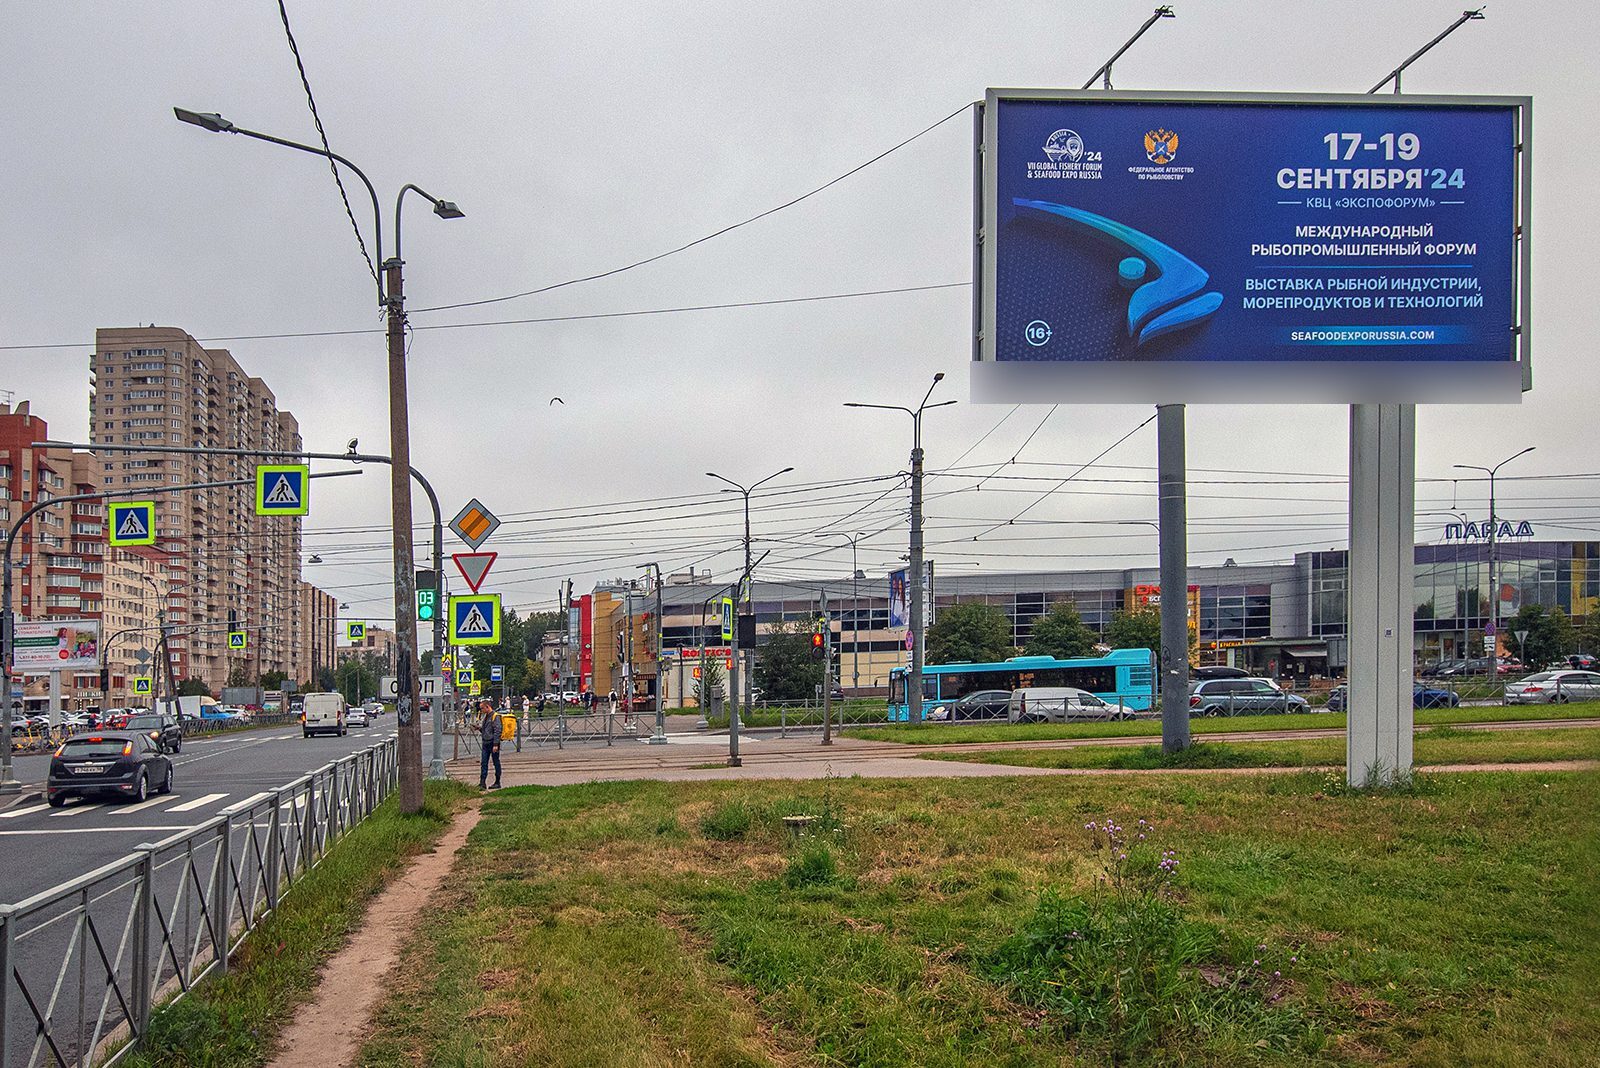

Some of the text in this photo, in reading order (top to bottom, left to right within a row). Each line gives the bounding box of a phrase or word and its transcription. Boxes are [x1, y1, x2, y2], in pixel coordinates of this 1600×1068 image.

[1323, 132, 1421, 161] 17-19
[1036, 163, 1058, 171] GLOBAL
[1059, 163, 1082, 171] FISHERY
[1083, 163, 1103, 171] FORUM
[1306, 197, 1436, 210] КВЦ «ЭКСПОФОРУМ»
[1295, 223, 1434, 240] МЕЖДУНАРОДНЫЙ
[1251, 241, 1477, 257] РЫБОПРОМЫШЛЕННЫЙ ФОРУМ
[1245, 276, 1482, 294] ВЫСТАВКА РЫБНОЙ ИНДУСТРИИ,
[1243, 293, 1484, 311] МОРЕПРОДУКТОВ И ТЕХНОЛОГИЙ
[1029, 327, 1052, 339] 16+
[1291, 330, 1435, 341] SEAFOODEXPORUSSIA.COM
[1446, 522, 1534, 539] ПАРАД
[419, 591, 434, 605] 03
